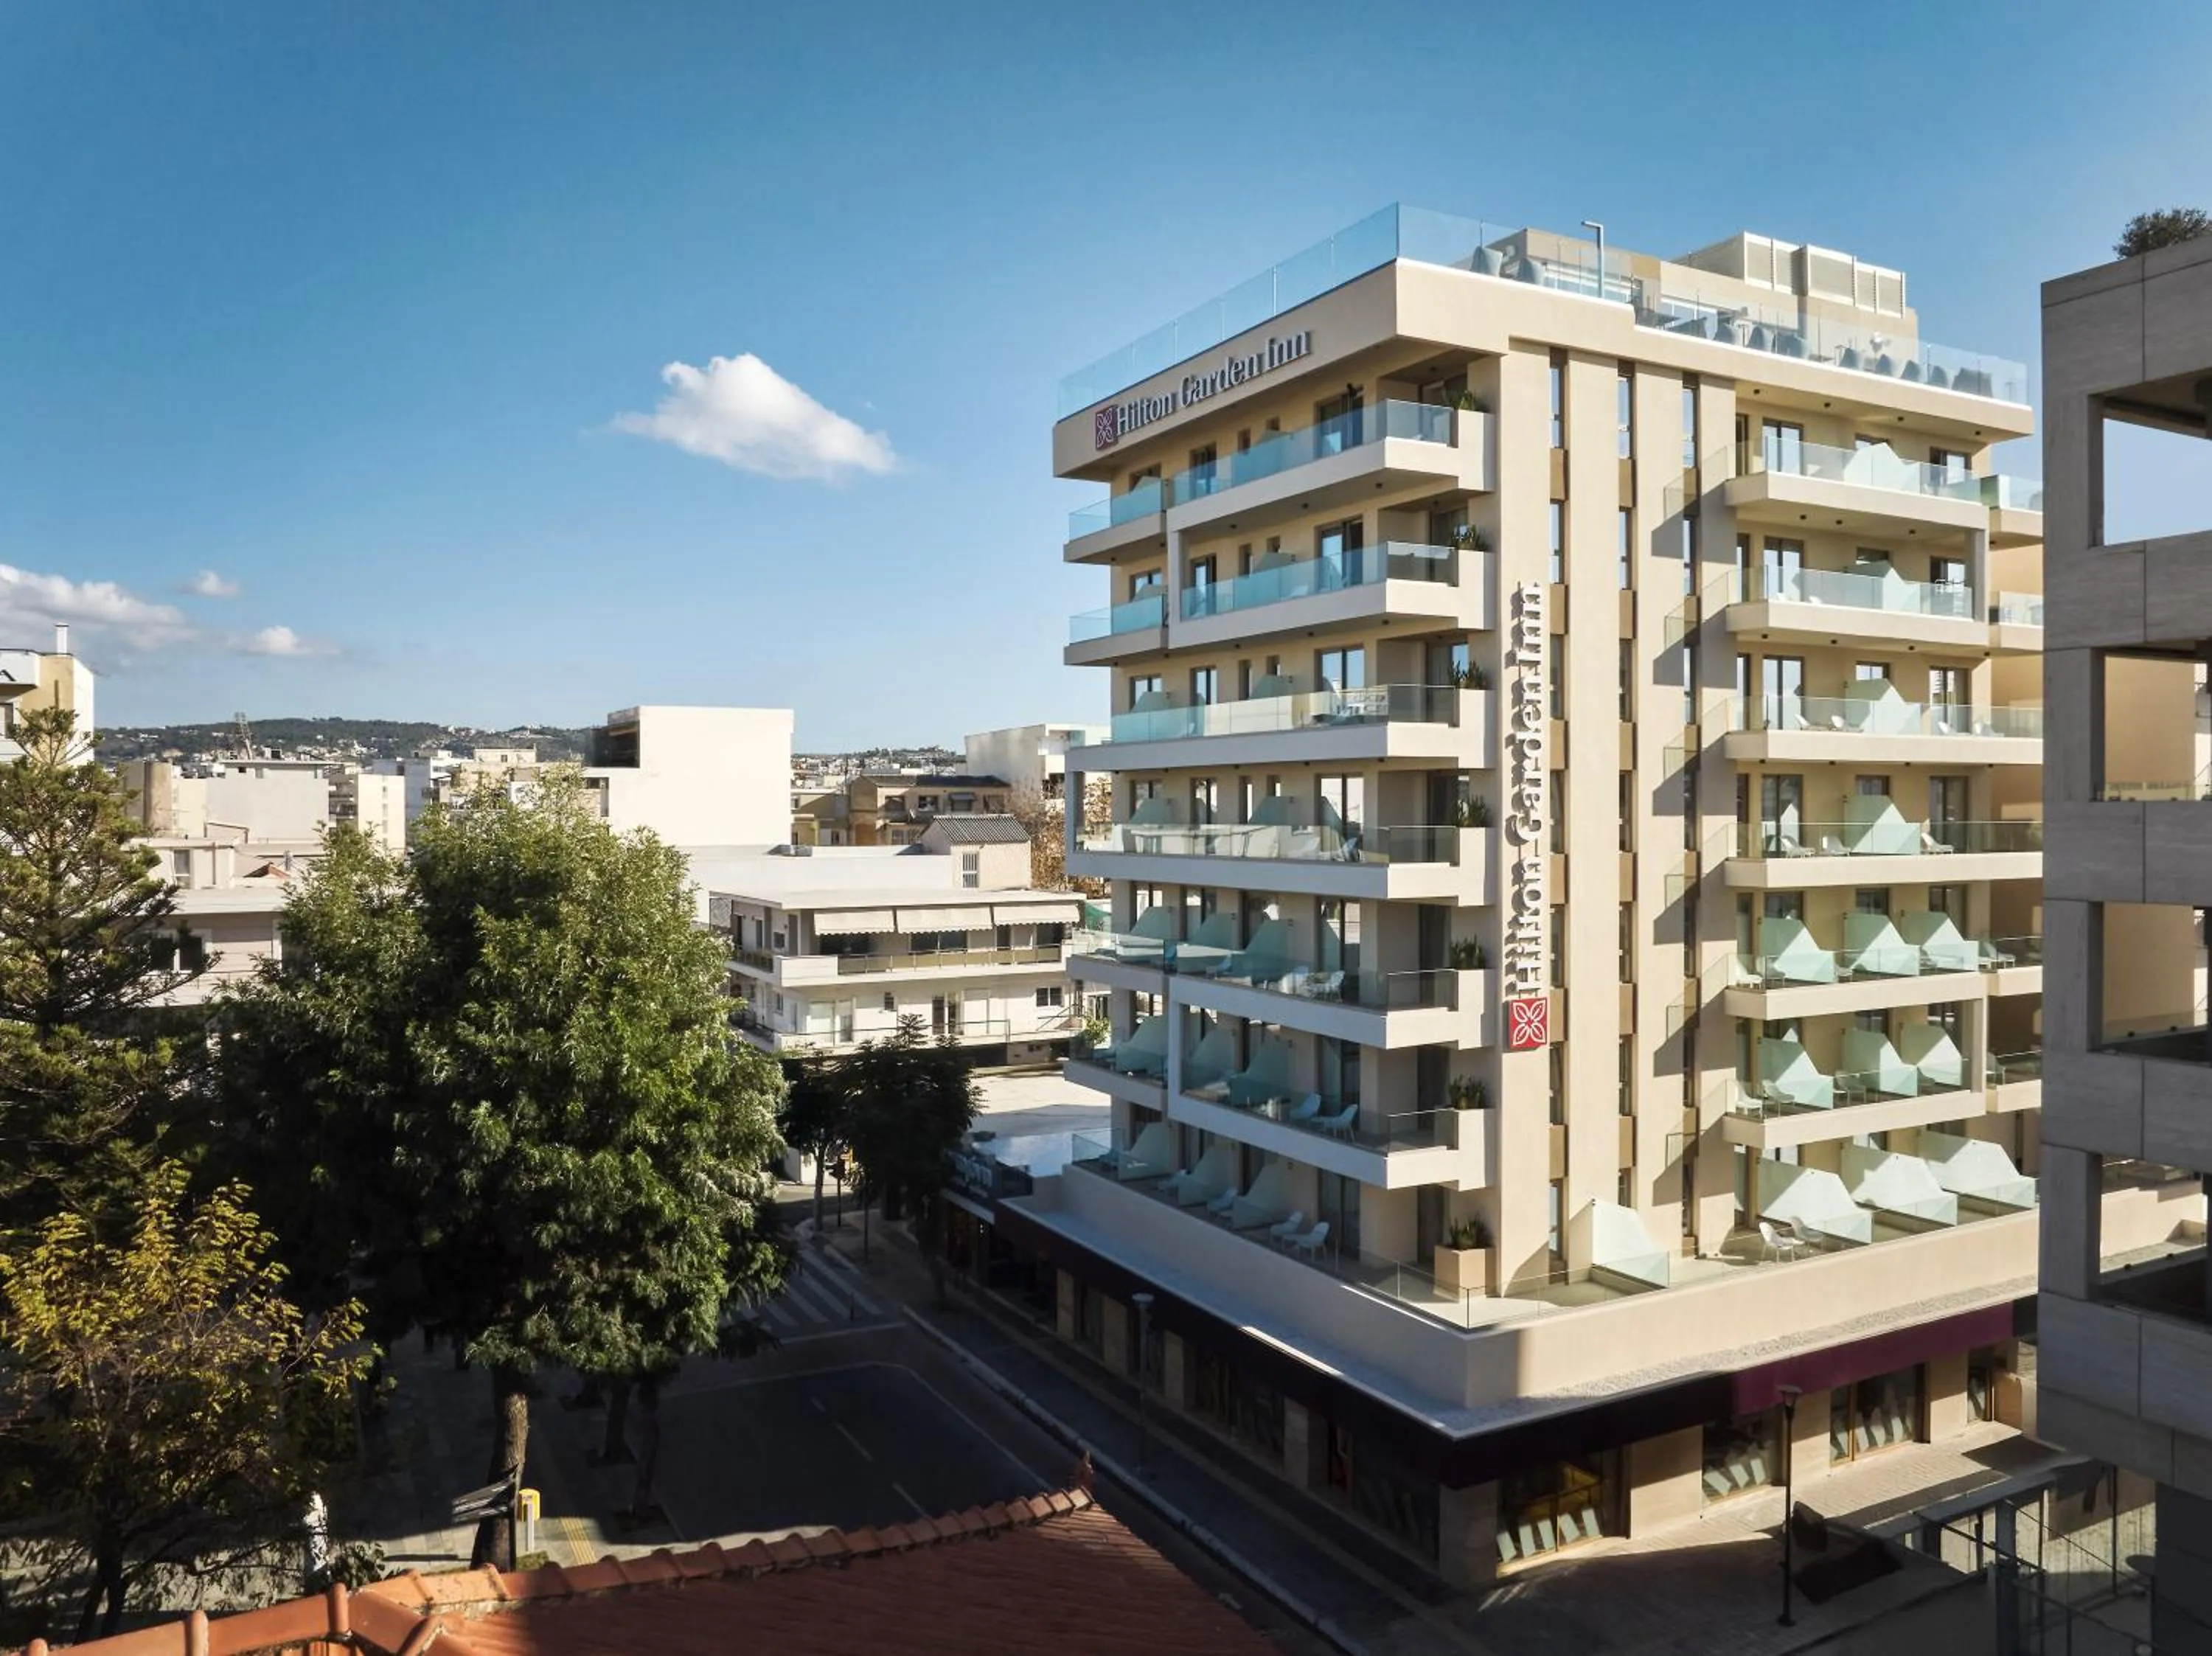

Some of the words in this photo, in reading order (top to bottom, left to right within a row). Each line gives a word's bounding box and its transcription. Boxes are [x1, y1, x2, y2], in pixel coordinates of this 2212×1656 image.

[1116, 392, 1173, 436] Hilton
[1180, 353, 1259, 408] Garden
[1265, 331, 1310, 371] Inn
[1516, 585, 1543, 664] Inn
[1515, 675, 1543, 842] Garden
[1516, 857, 1543, 992] Hilton
